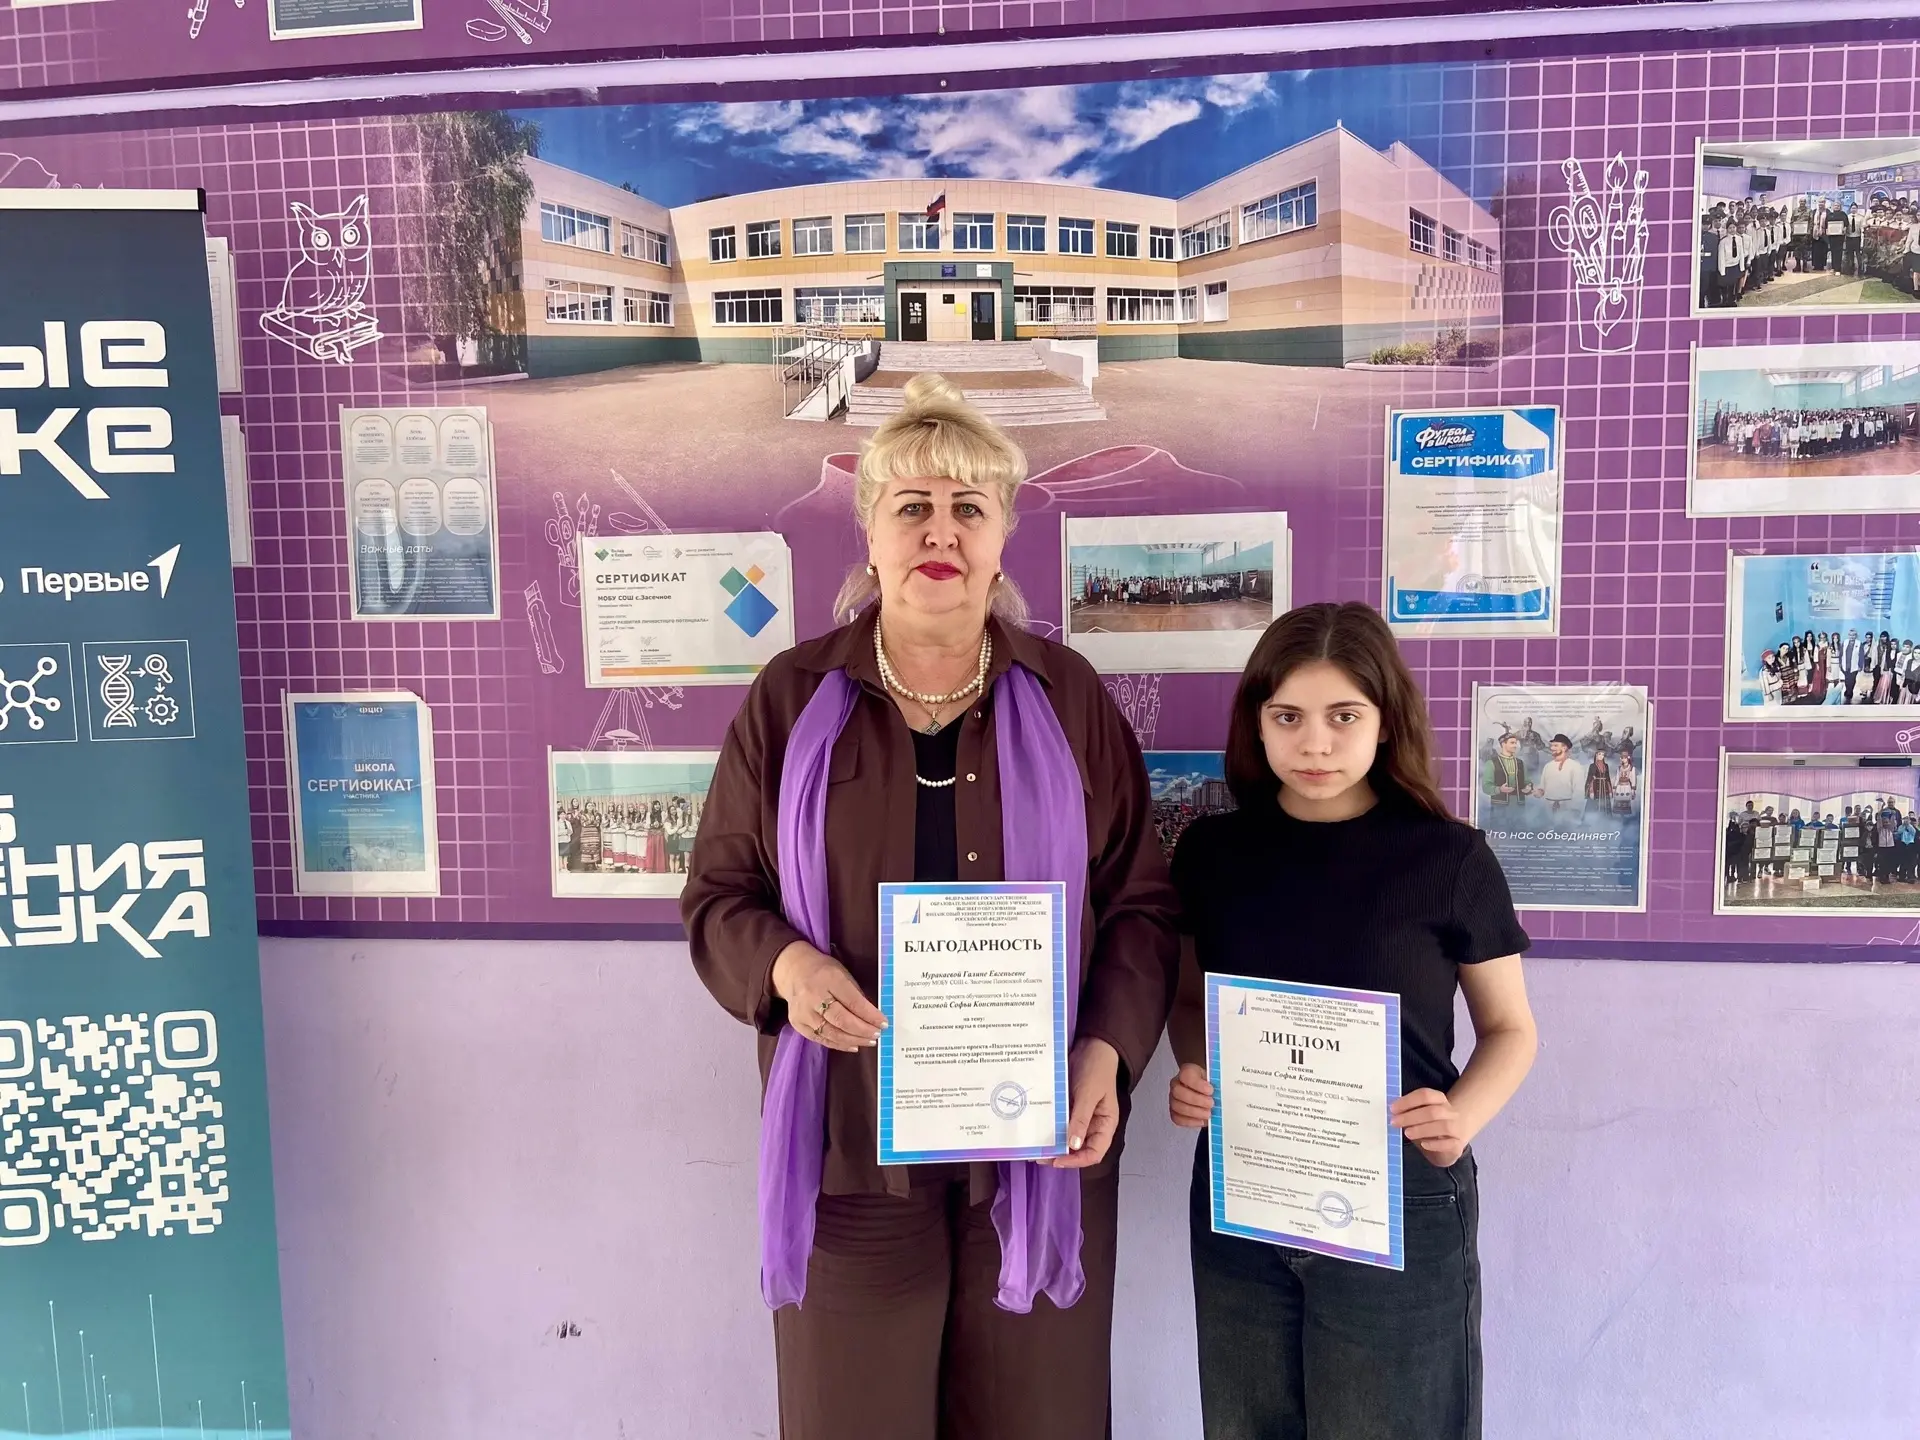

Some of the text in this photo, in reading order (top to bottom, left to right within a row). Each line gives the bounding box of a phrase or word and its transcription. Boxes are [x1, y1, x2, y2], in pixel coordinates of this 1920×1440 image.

[1411, 454, 1534, 468] СЕРТИФИКАТ
[360, 544, 433, 554] Важные даты
[21, 567, 149, 601] Первые
[596, 572, 687, 584] СЕРТИФИКАТ
[354, 763, 395, 772] ШКОЛА
[307, 779, 413, 792] СЕРТИФИКАТ
[1509, 831, 1534, 840] нас
[1537, 829, 1620, 842] объединяет?
[0, 840, 205, 895] НИЯ
[0, 891, 210, 958] УКА
[904, 939, 1042, 953] БЛАГОДАРНОСТЬ
[1259, 1031, 1340, 1052] ДИПЛОМ
[1291, 1049, 1304, 1065] II
[1241, 1066, 1363, 1089] Казакова Софья Константиновна
